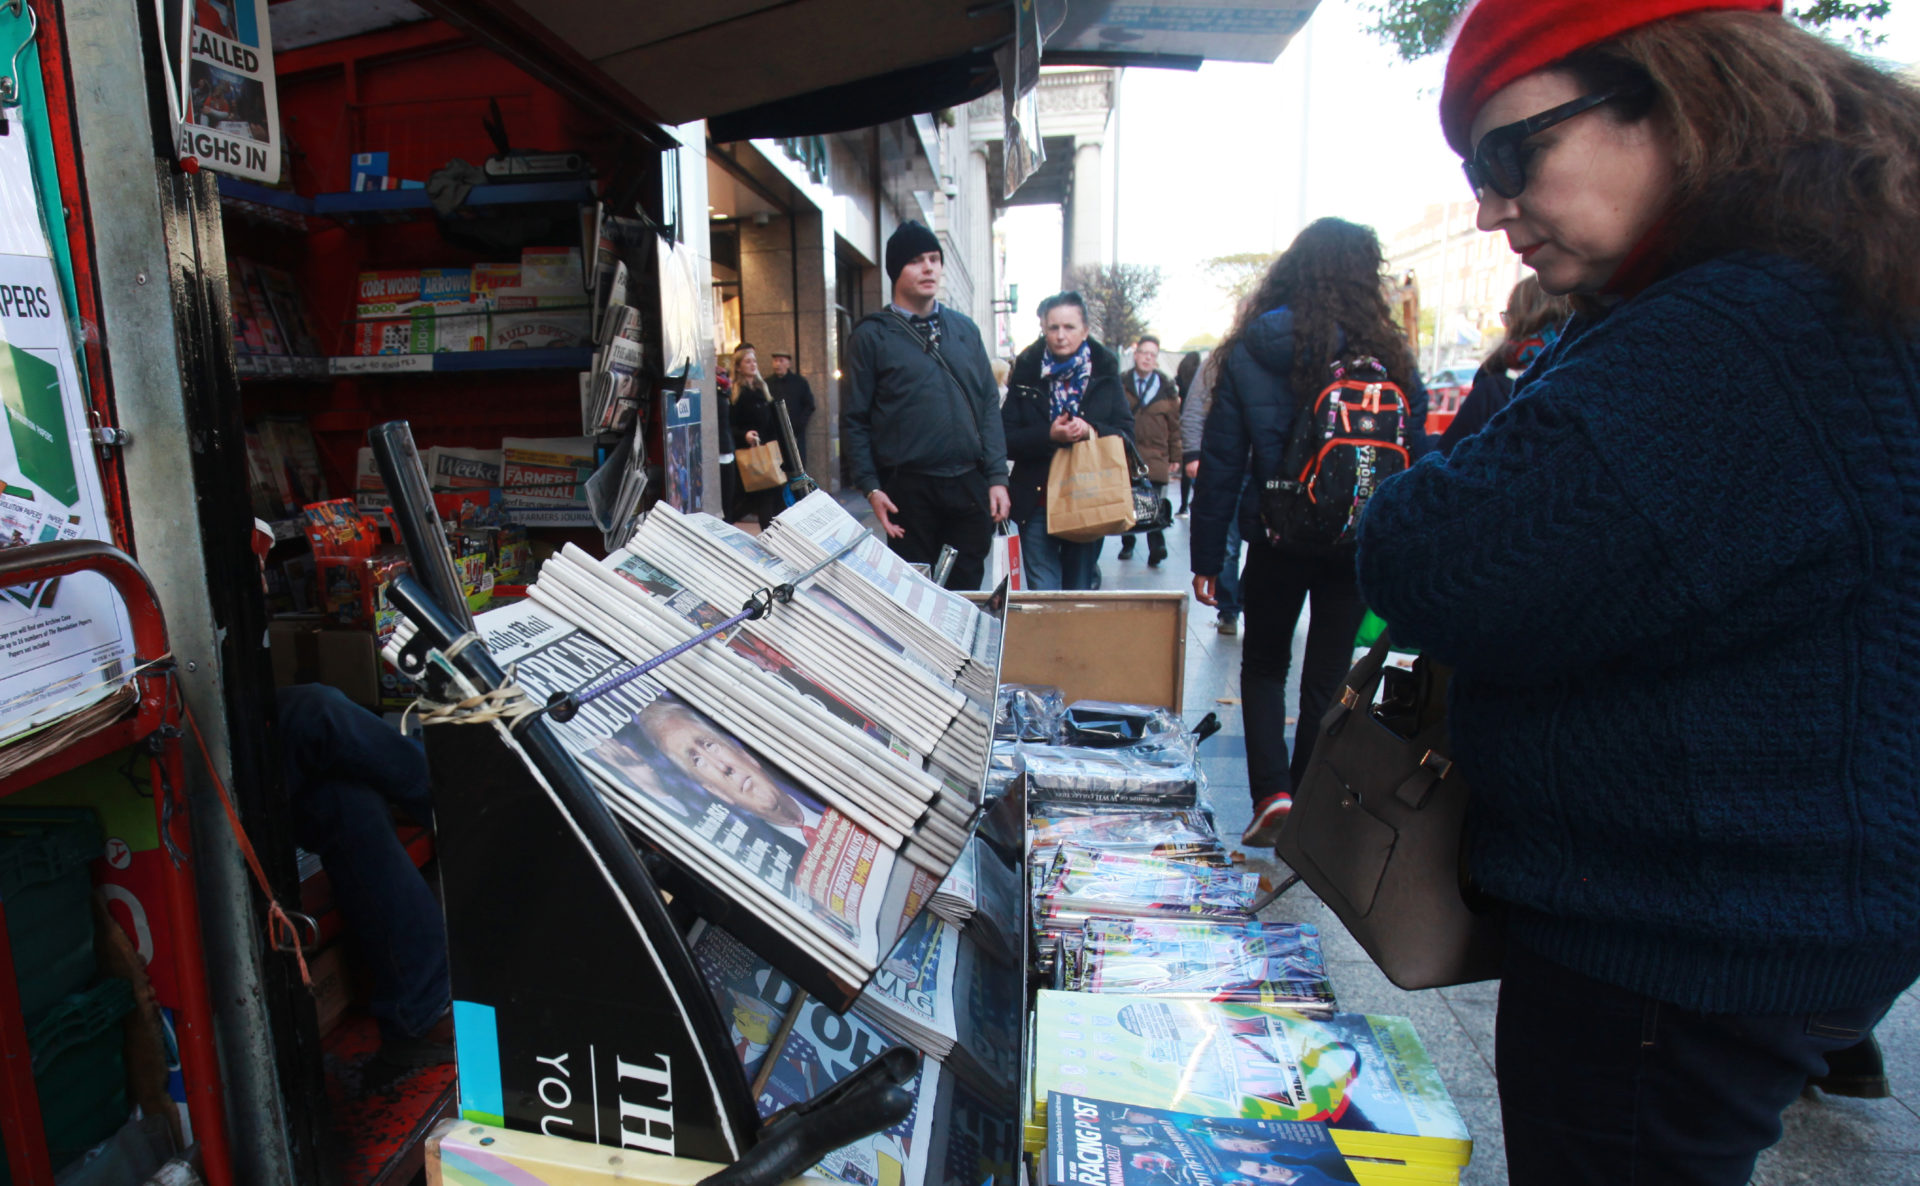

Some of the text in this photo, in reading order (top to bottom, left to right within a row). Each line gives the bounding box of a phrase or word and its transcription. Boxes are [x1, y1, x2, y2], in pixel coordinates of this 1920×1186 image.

[245, 144, 267, 173] IN
[361, 279, 385, 299] CODE
[498, 324, 534, 345] AULD
[505, 469, 574, 486] FARMERS
[520, 511, 555, 521] FARMERS
[513, 632, 622, 702] ERICAN
[1073, 1097, 1107, 1186] RACING POST
